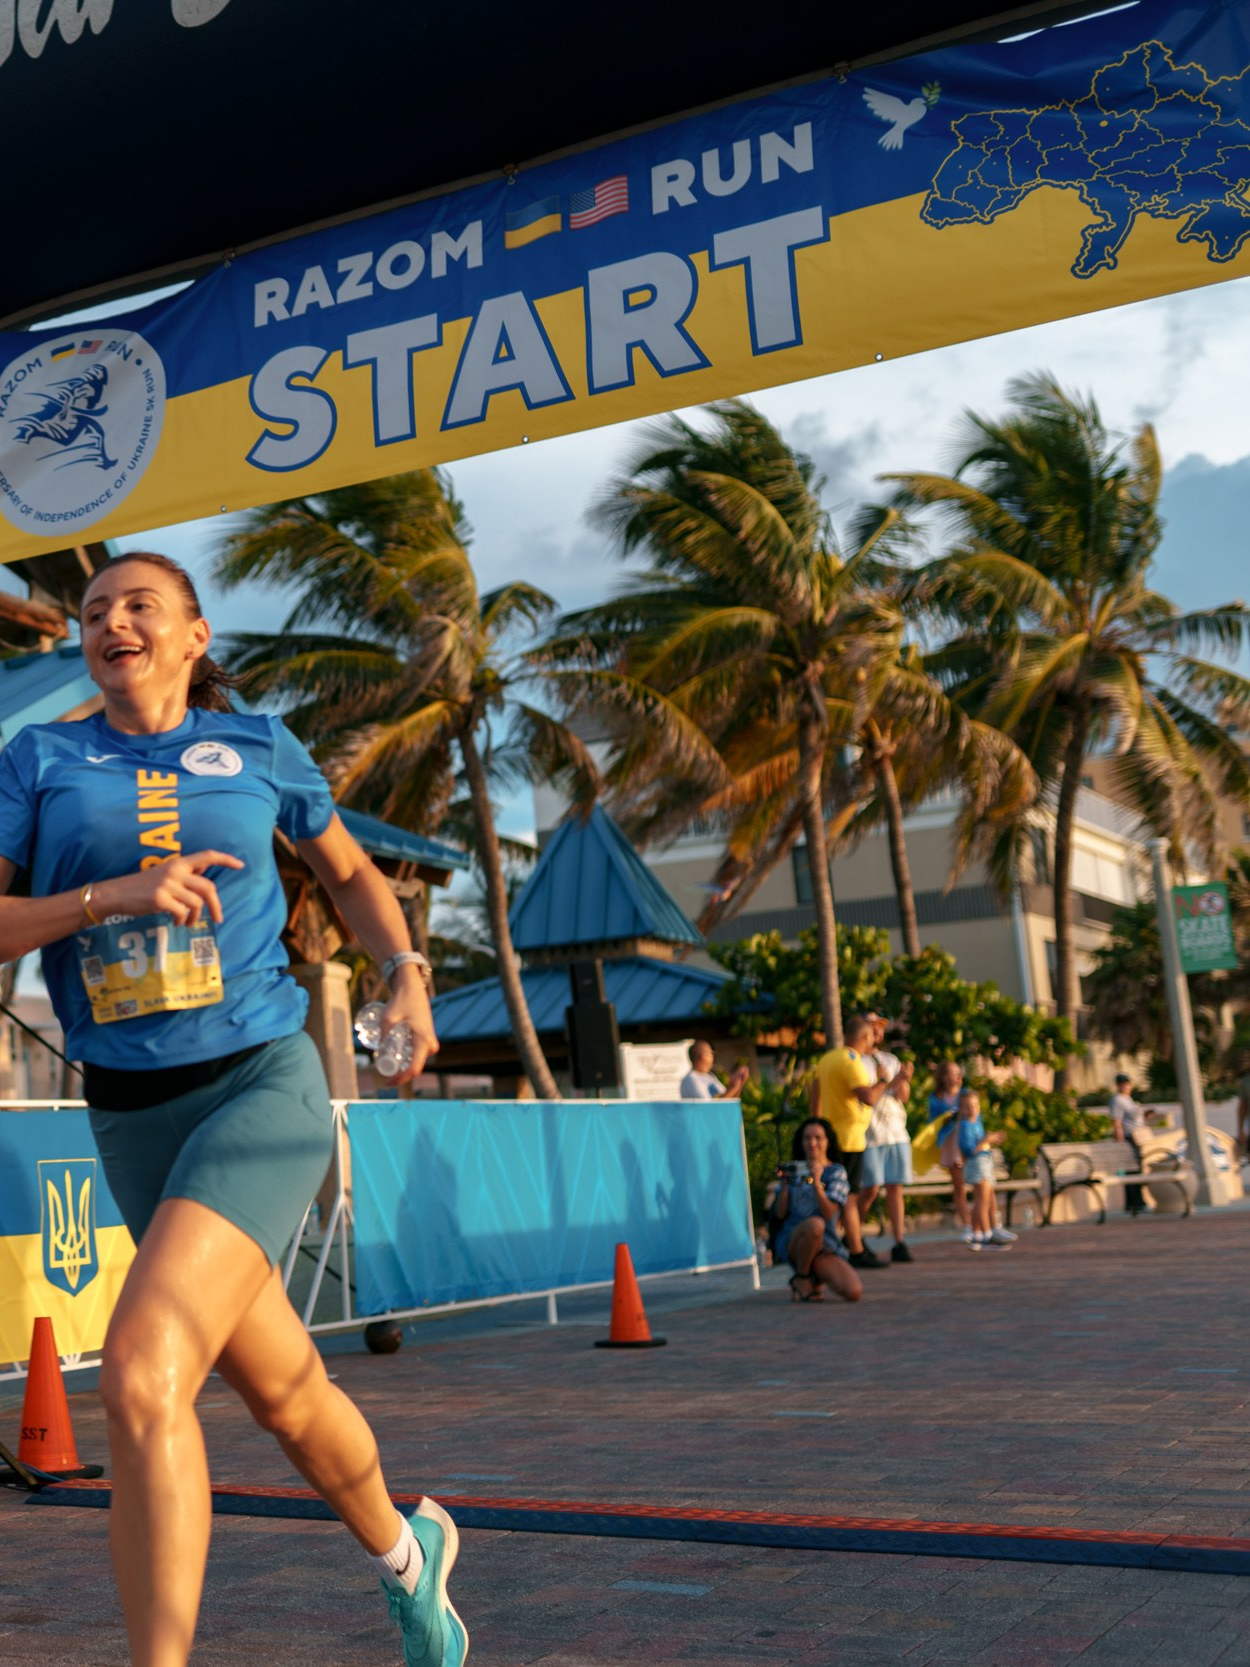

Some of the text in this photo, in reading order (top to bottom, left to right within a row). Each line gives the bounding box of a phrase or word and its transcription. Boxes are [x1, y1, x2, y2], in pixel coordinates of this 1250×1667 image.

[254, 120, 815, 328] RAZOM RUN
[245, 205, 831, 473] START
[19, 503, 34, 516] OF
[32, 488, 114, 523] INDEPENDENCE
[113, 471, 128, 490] OF
[126, 414, 154, 471] UKRAINE
[142, 368, 156, 394] RUN
[118, 925, 169, 979] 37
[21, 1426, 48, 1441] SST
